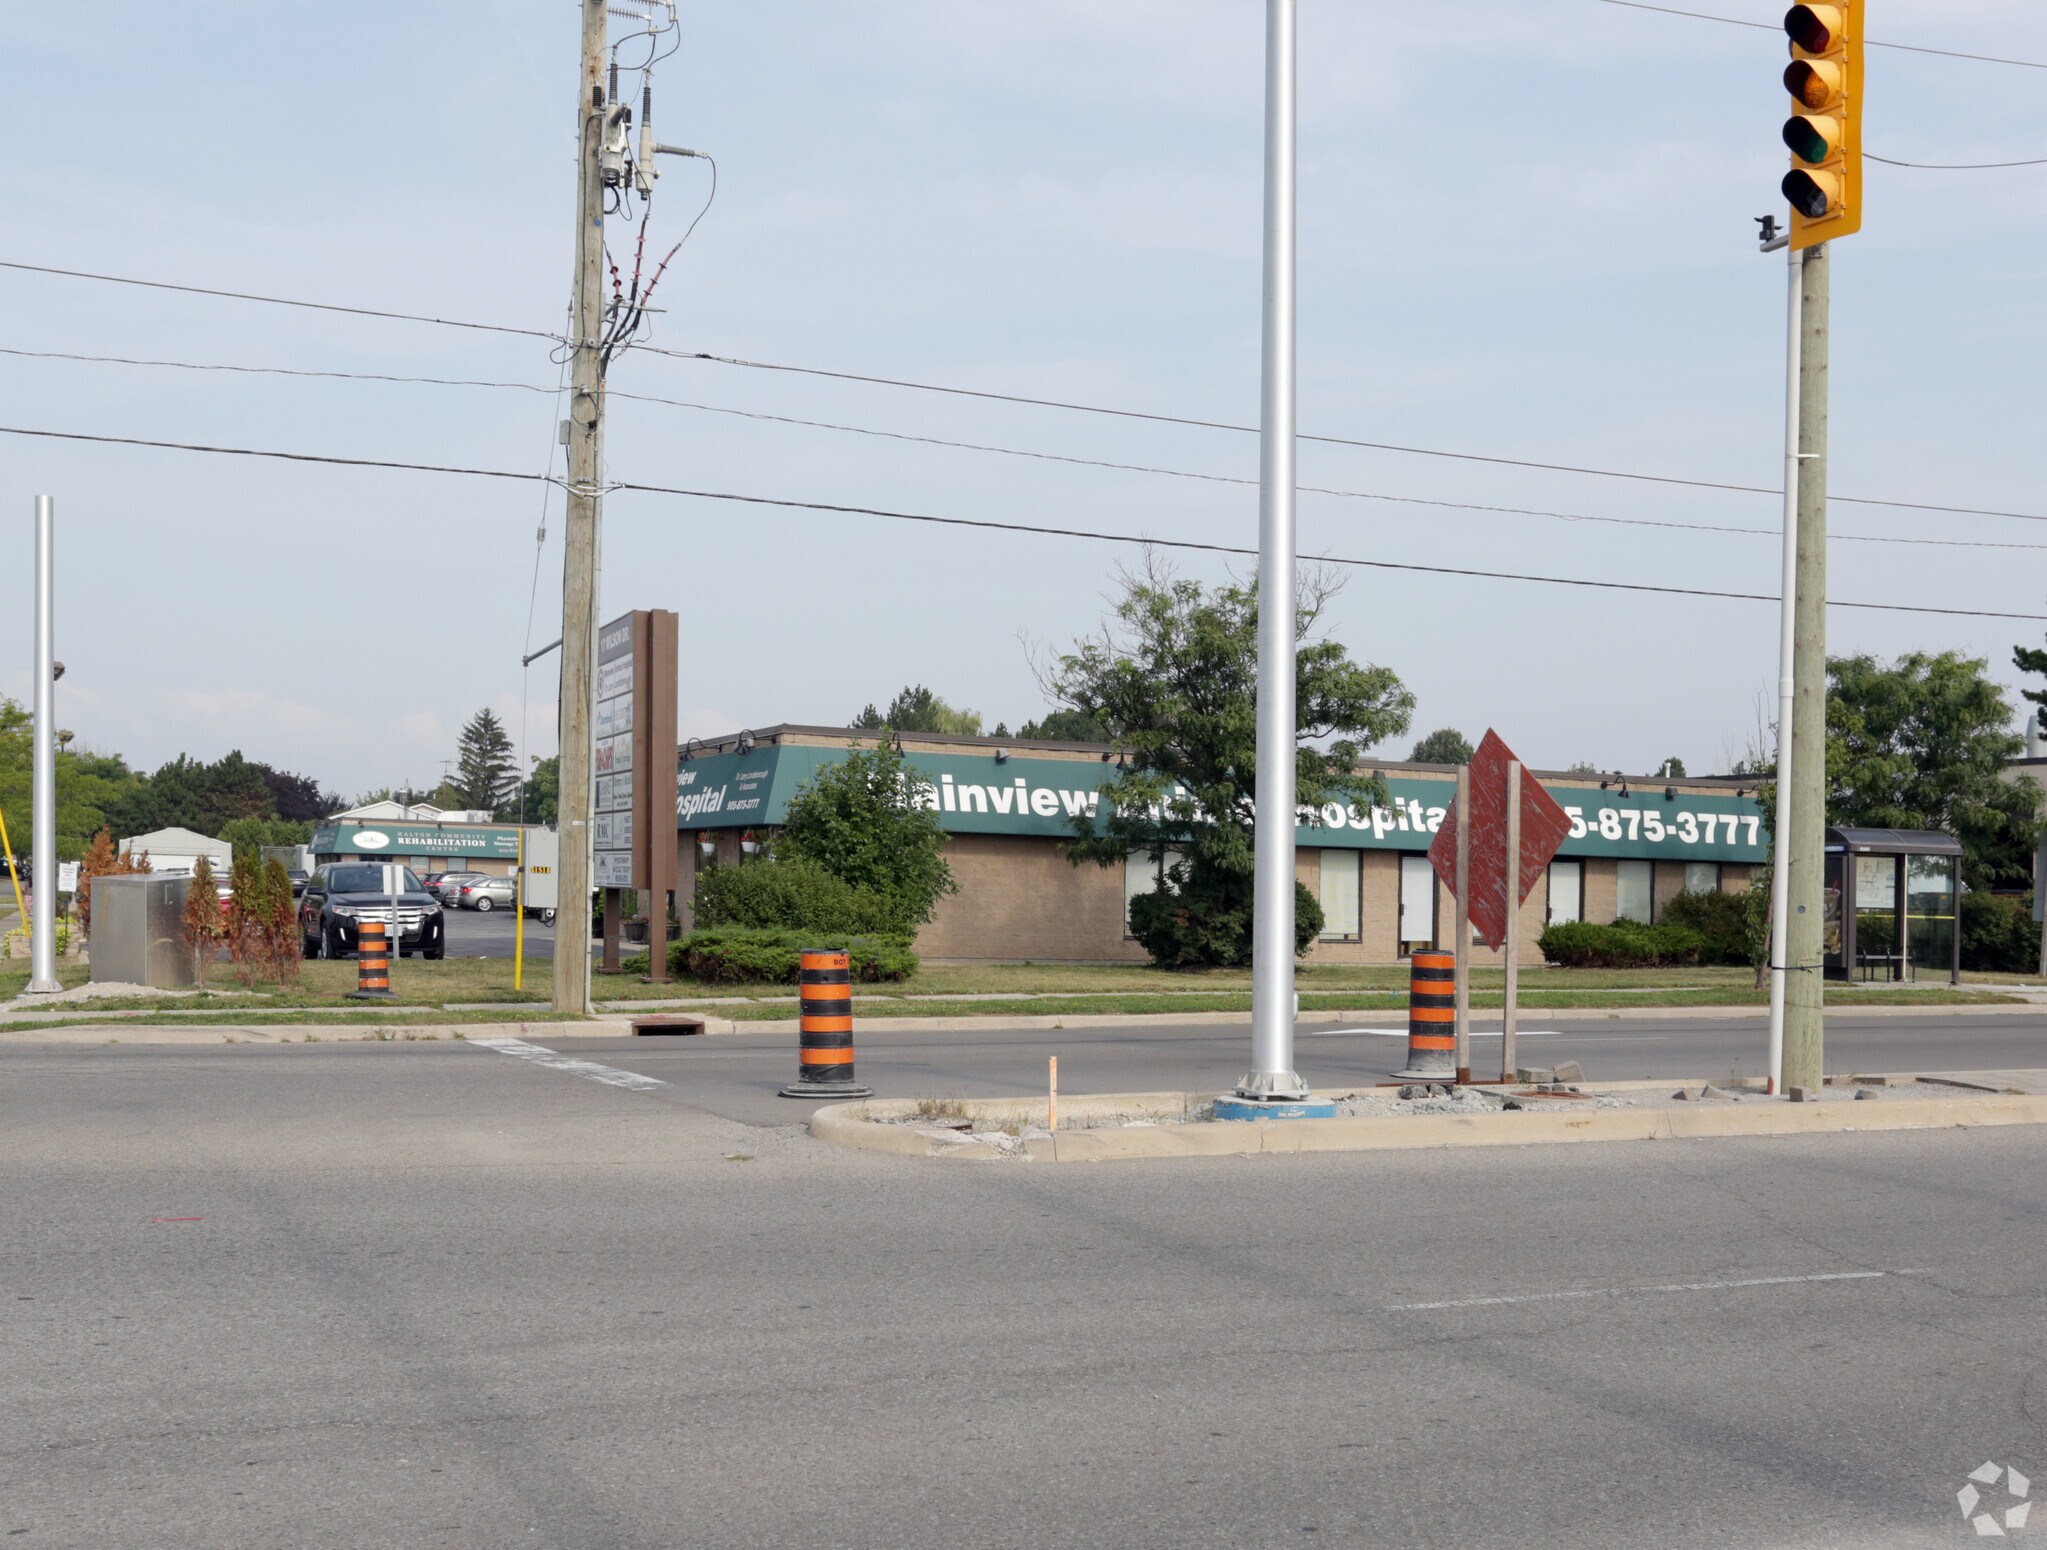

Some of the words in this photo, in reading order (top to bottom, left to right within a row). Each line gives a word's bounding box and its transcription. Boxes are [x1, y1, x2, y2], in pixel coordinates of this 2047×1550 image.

[1295, 797, 1452, 839] ospita
[435, 832, 486, 840] COMMUNITY
[398, 837, 486, 847] REHABILITATION
